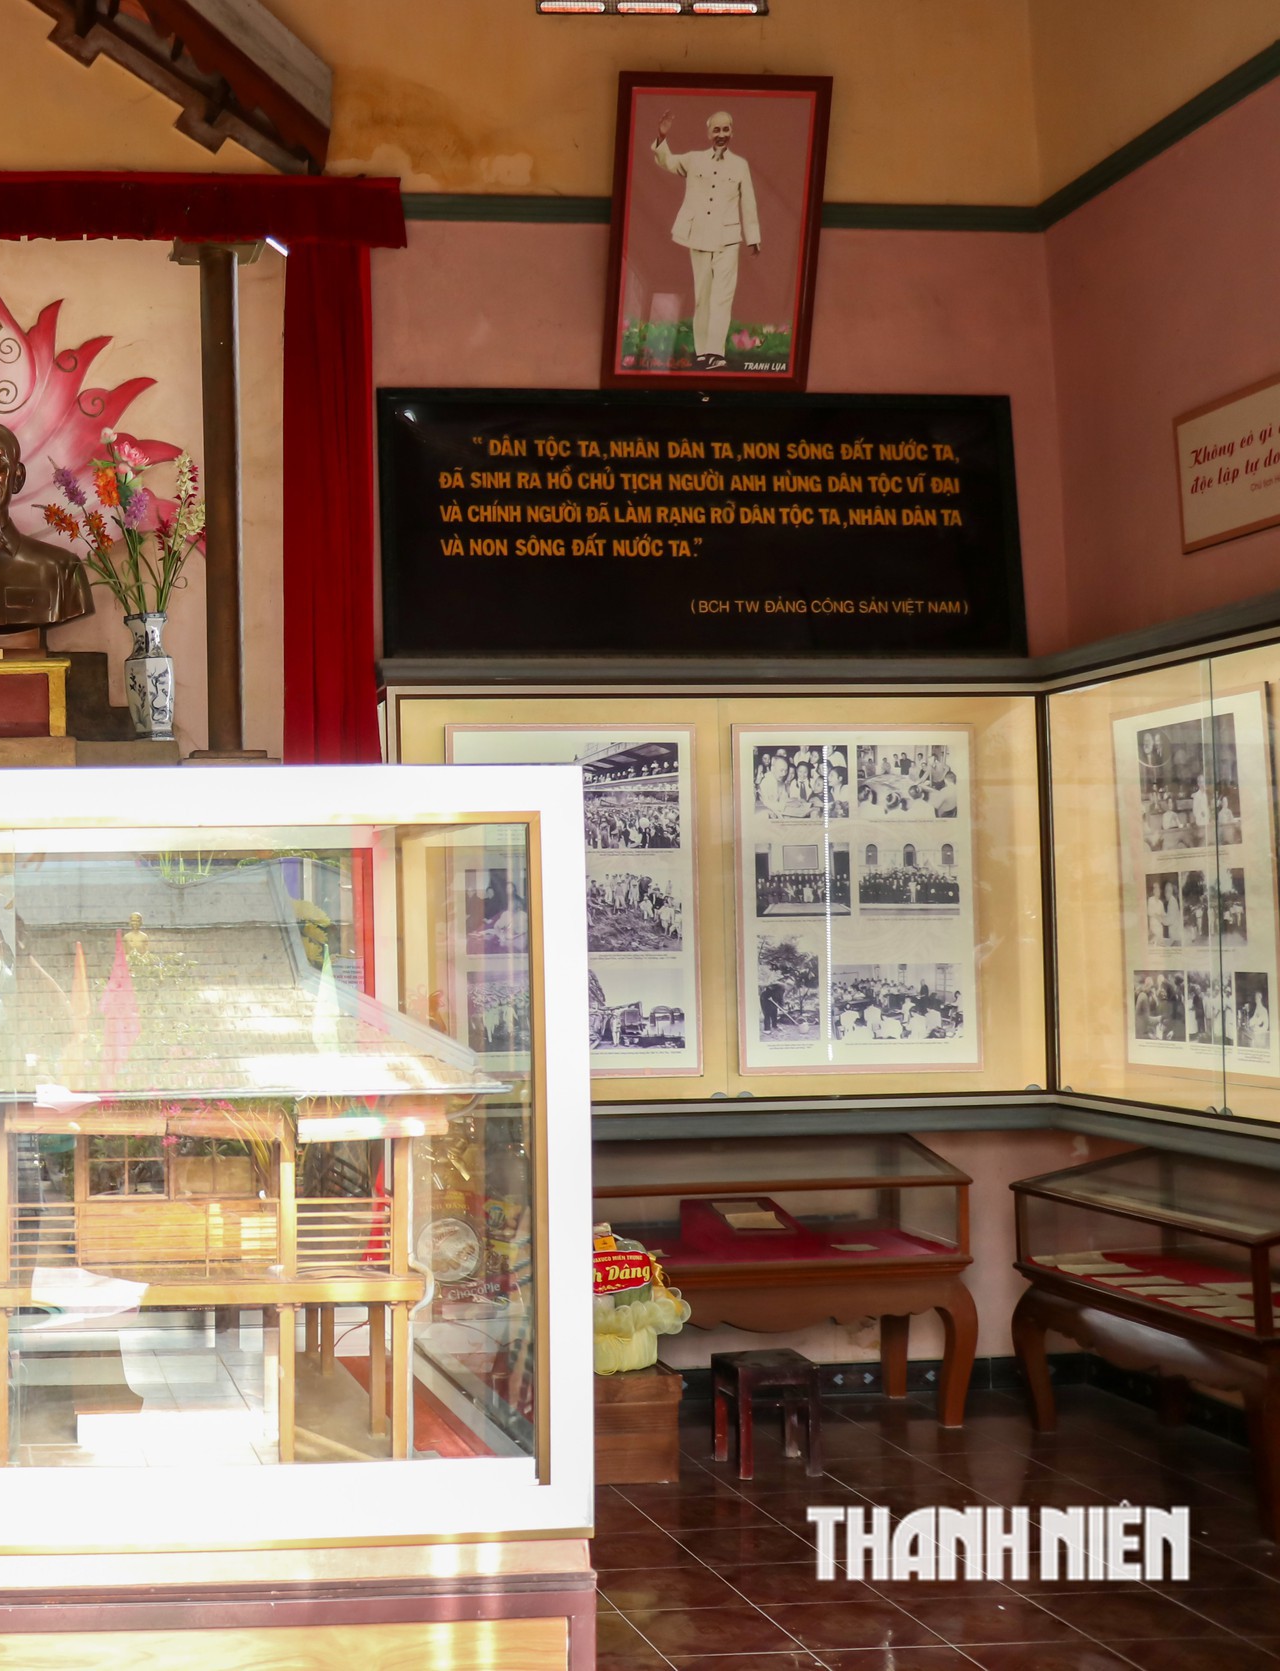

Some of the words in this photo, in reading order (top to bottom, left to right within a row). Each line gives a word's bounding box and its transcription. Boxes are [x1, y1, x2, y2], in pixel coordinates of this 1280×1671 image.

[744, 362, 769, 370] TRANH
[772, 363, 787, 372] LỤA
[488, 434, 527, 457] DÂN
[534, 436, 571, 460] TỘC
[667, 438, 704, 460] DÂN
[786, 439, 834, 460] SÔNG
[840, 437, 873, 461] ĐẤT
[879, 438, 928, 462] NƯỚC
[932, 444, 960, 464] TA,
[438, 467, 464, 489] ĐÃ
[470, 471, 511, 489] SINH
[517, 472, 542, 489] RA
[547, 465, 572, 490] HỒ
[577, 465, 615, 490] CHỦ
[620, 472, 662, 493] TỊCH
[669, 468, 724, 491] NGƯỜI
[730, 475, 766, 492] ANH
[773, 470, 822, 493] HÙNG
[827, 473, 863, 493] DÂN
[867, 473, 902, 497] TỘC
[906, 472, 925, 493] VĨ
[930, 477, 960, 496] ĐẠI
[1190, 476, 1213, 494] độc
[1218, 467, 1239, 485] lập
[1245, 459, 1260, 475] tự
[440, 499, 463, 523] VÀ
[467, 500, 521, 523] CHÍNH
[527, 500, 582, 523] NGƯỜI
[586, 501, 610, 523] ĐÃ
[614, 500, 652, 524] LÀM
[656, 505, 706, 527] RẠNG
[710, 501, 736, 525] RỠ
[739, 504, 776, 525] DÂN
[779, 504, 814, 528] TỘC
[901, 506, 937, 526] DÂN
[940, 509, 963, 526] TA
[440, 533, 464, 557] VÀ
[470, 539, 508, 556] NON
[515, 535, 565, 557] SÔNG
[571, 533, 607, 557] ĐẤT
[612, 533, 663, 557] NƯỚC
[734, 600, 760, 613] TW
[764, 596, 807, 614] ĐẢNG
[810, 597, 855, 616] CỘNG
[858, 596, 889, 614] SẢN
[892, 598, 925, 616] VIỆT
[606, 1264, 650, 1282] Dâng
